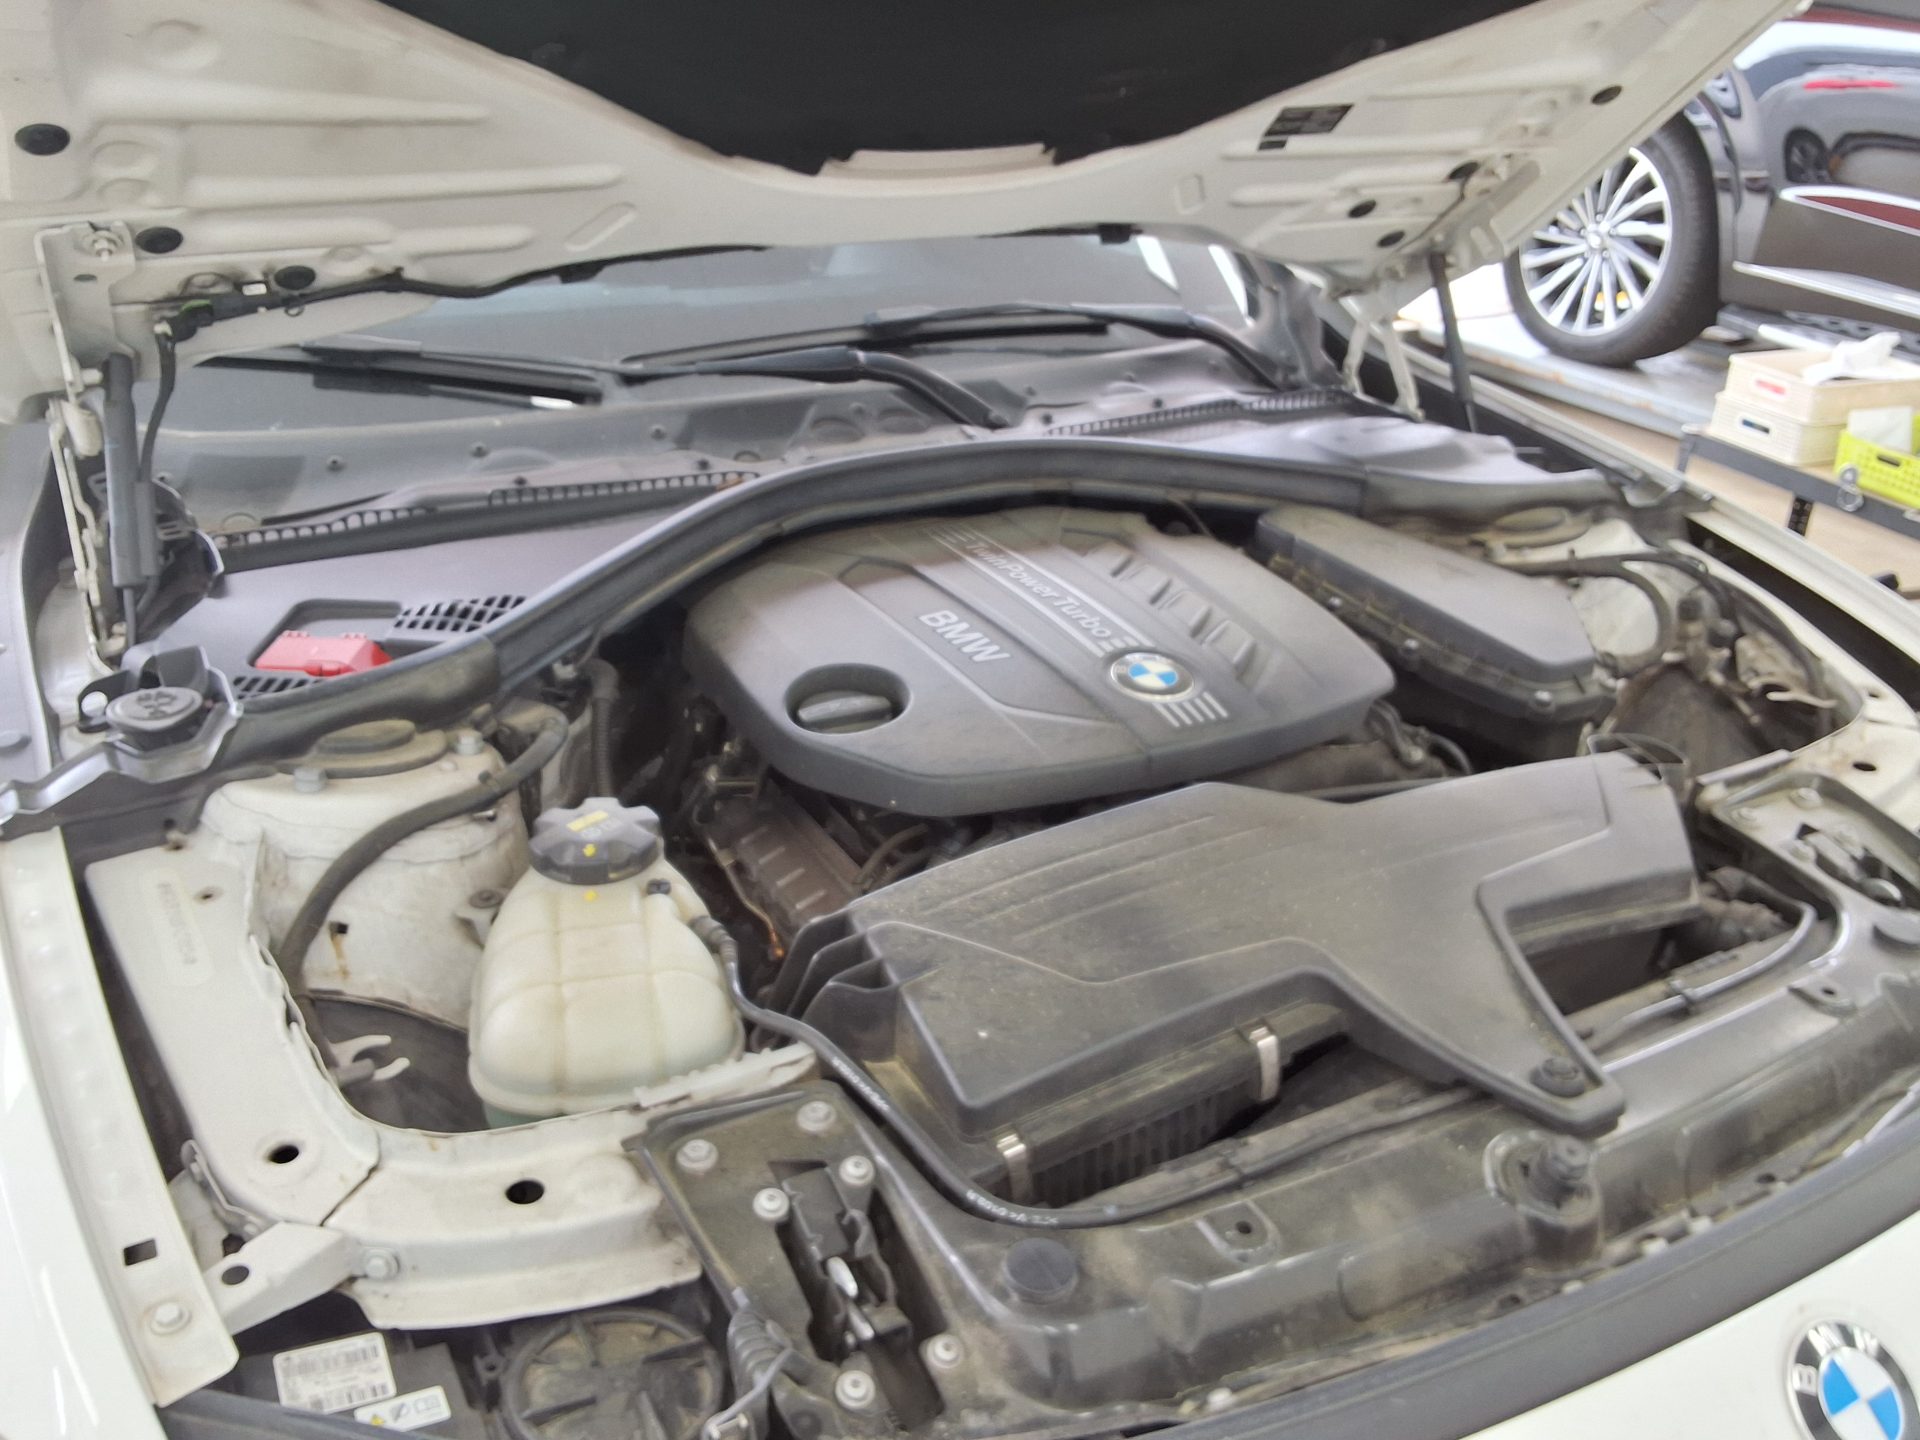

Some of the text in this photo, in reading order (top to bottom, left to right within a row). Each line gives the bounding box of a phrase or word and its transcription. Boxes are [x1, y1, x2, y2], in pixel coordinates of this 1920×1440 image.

[919, 610, 1010, 663] BMW
[1053, 596, 1111, 639] Turbo
[1791, 1321, 1879, 1397] BMW
